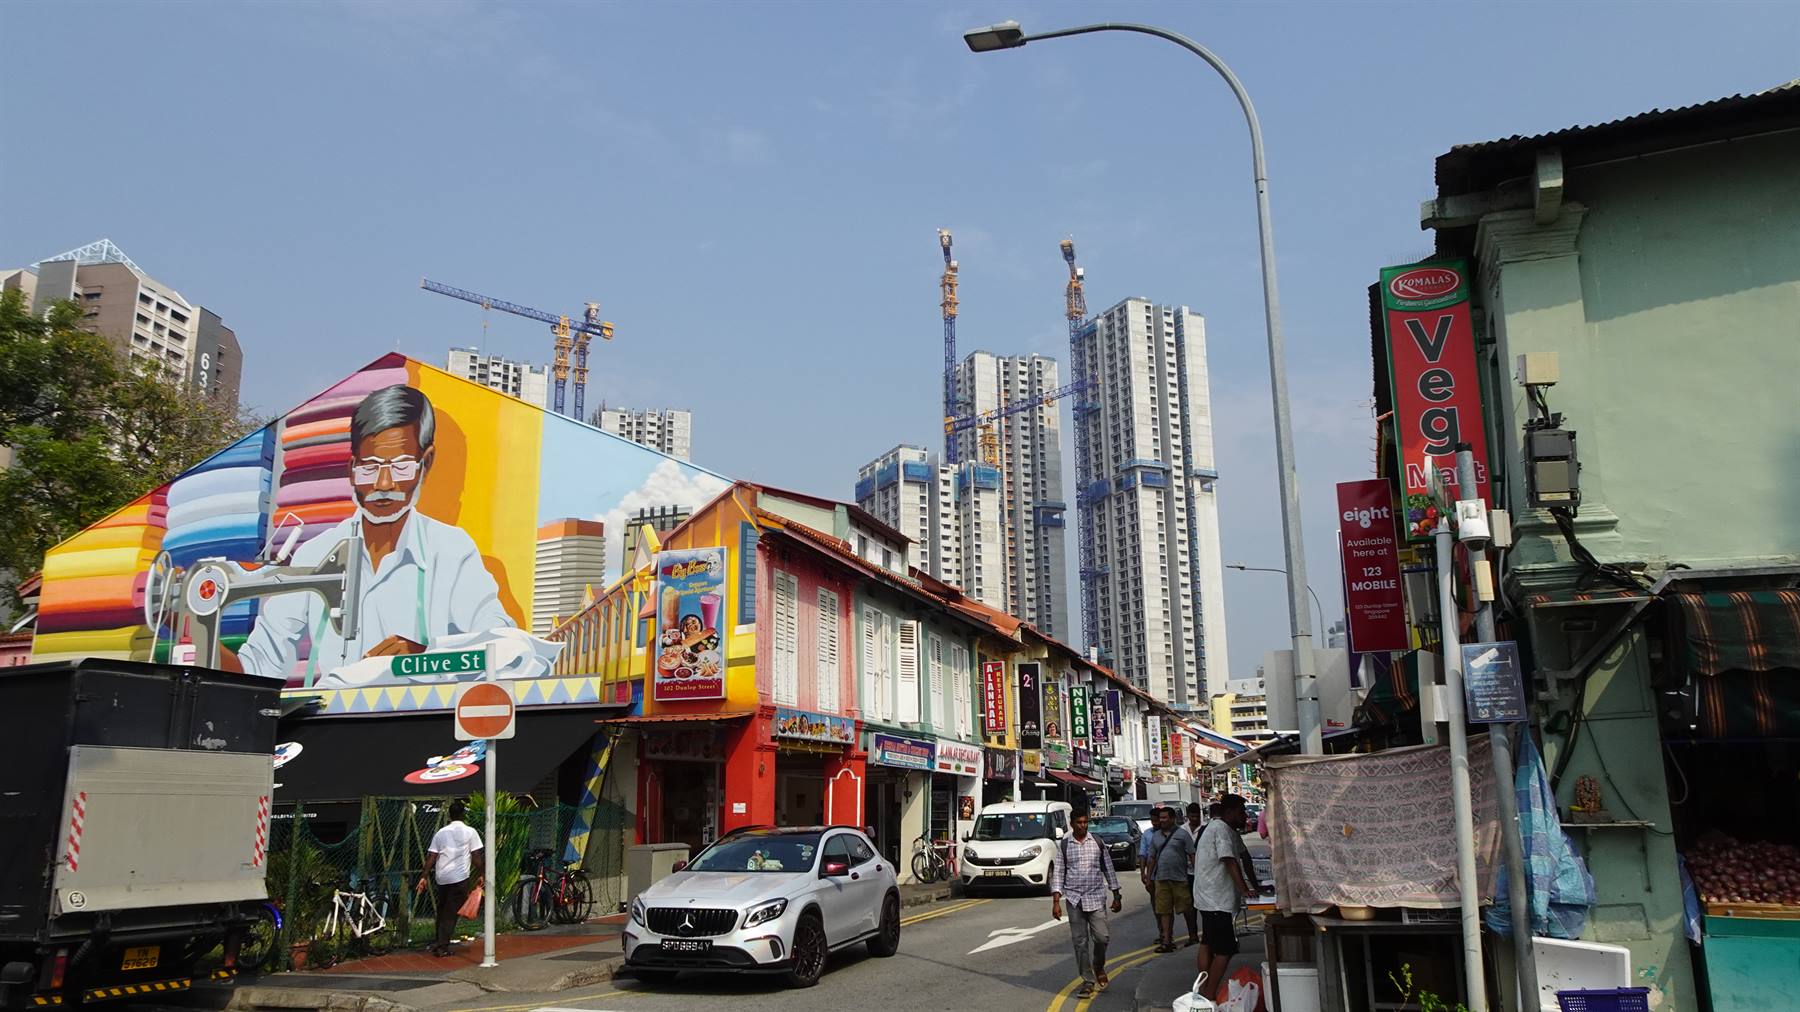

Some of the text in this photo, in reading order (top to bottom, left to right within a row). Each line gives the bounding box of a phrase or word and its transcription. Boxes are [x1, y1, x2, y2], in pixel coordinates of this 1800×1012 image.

[1404, 315, 1461, 456] Veg
[1343, 506, 1390, 528] eight
[1347, 537, 1392, 547] Available
[1353, 548, 1388, 558] here at
[1363, 567, 1382, 577] 123
[1352, 580, 1397, 592] MOBILE
[401, 653, 480, 674] Clive St
[986, 664, 996, 728] ALANKAR
[1073, 688, 1085, 735] NALAA
